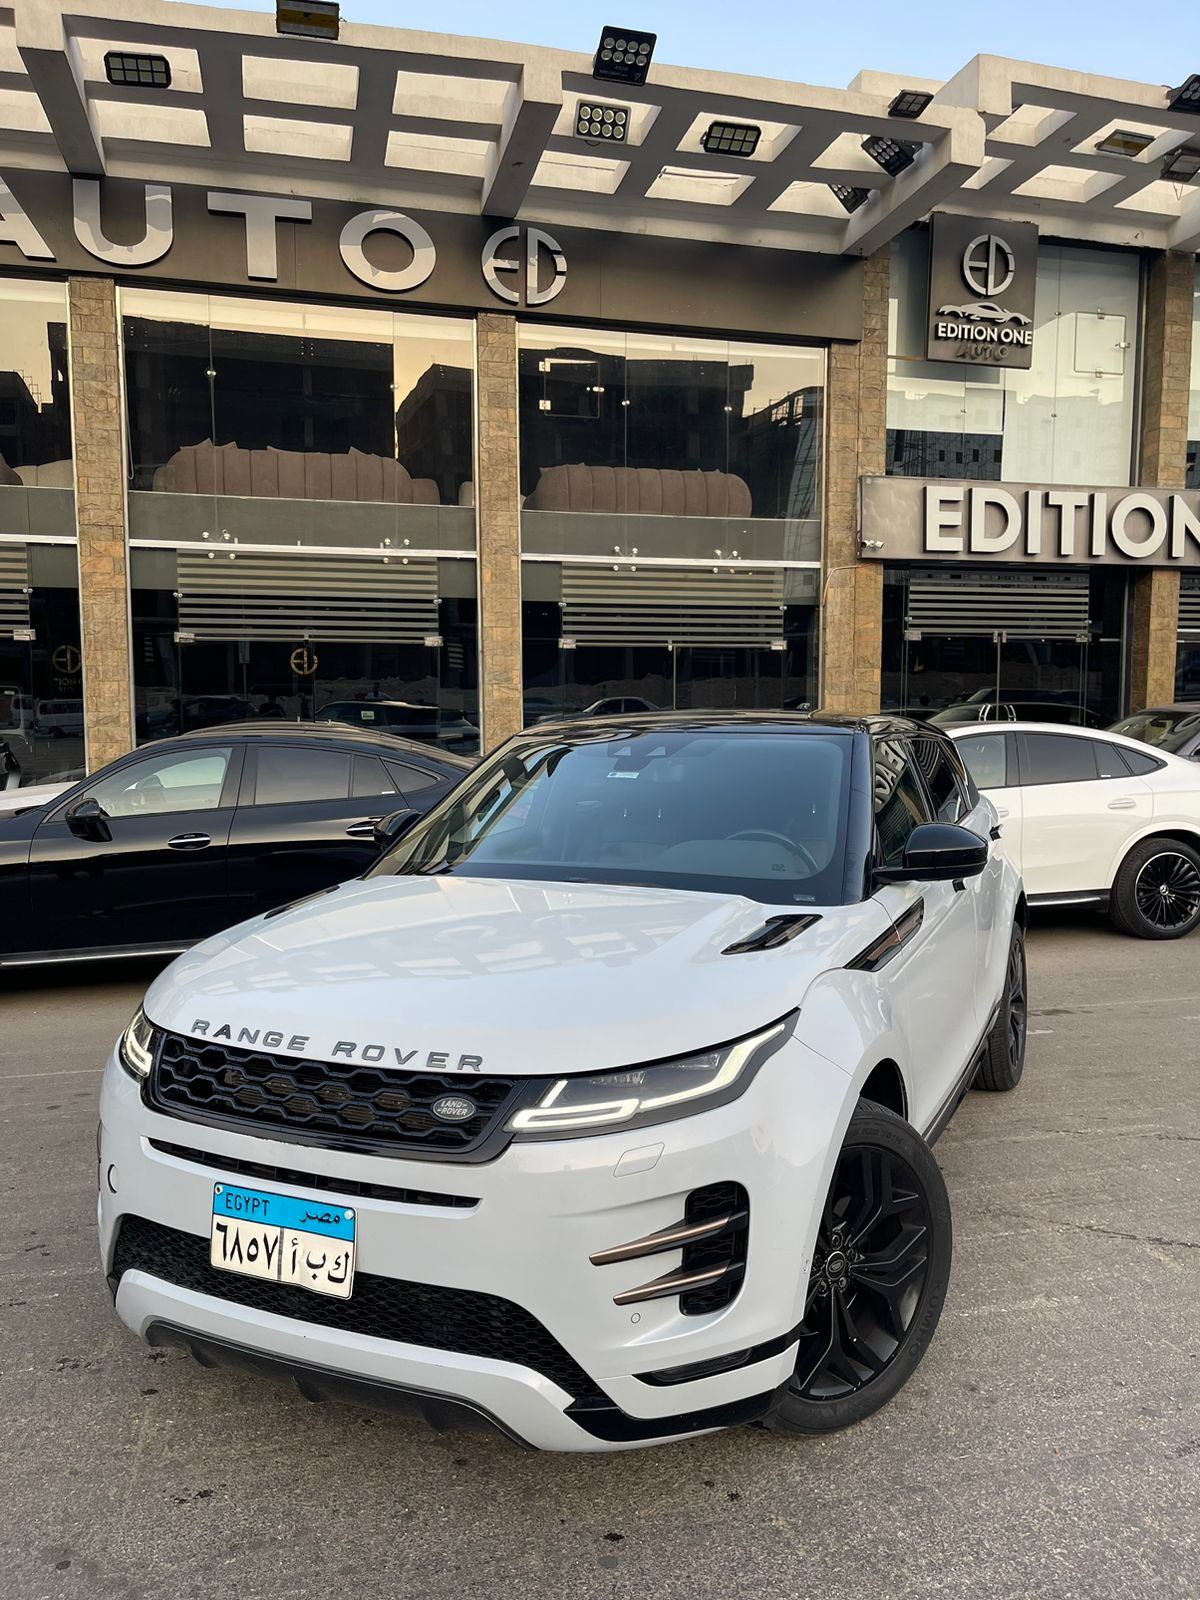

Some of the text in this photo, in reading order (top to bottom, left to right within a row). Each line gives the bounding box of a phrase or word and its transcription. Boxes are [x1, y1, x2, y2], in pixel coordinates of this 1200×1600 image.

[938, 322, 1033, 345] EDITION ONE
[955, 343, 1010, 361] AUTO
[926, 485, 1200, 559] EDITION
[190, 1019, 484, 1072] RANGE ROVER
[225, 1192, 270, 1216] EGYPT
[299, 1209, 341, 1224] مصر
[215, 1222, 279, 1270] ٦٨٥٧
